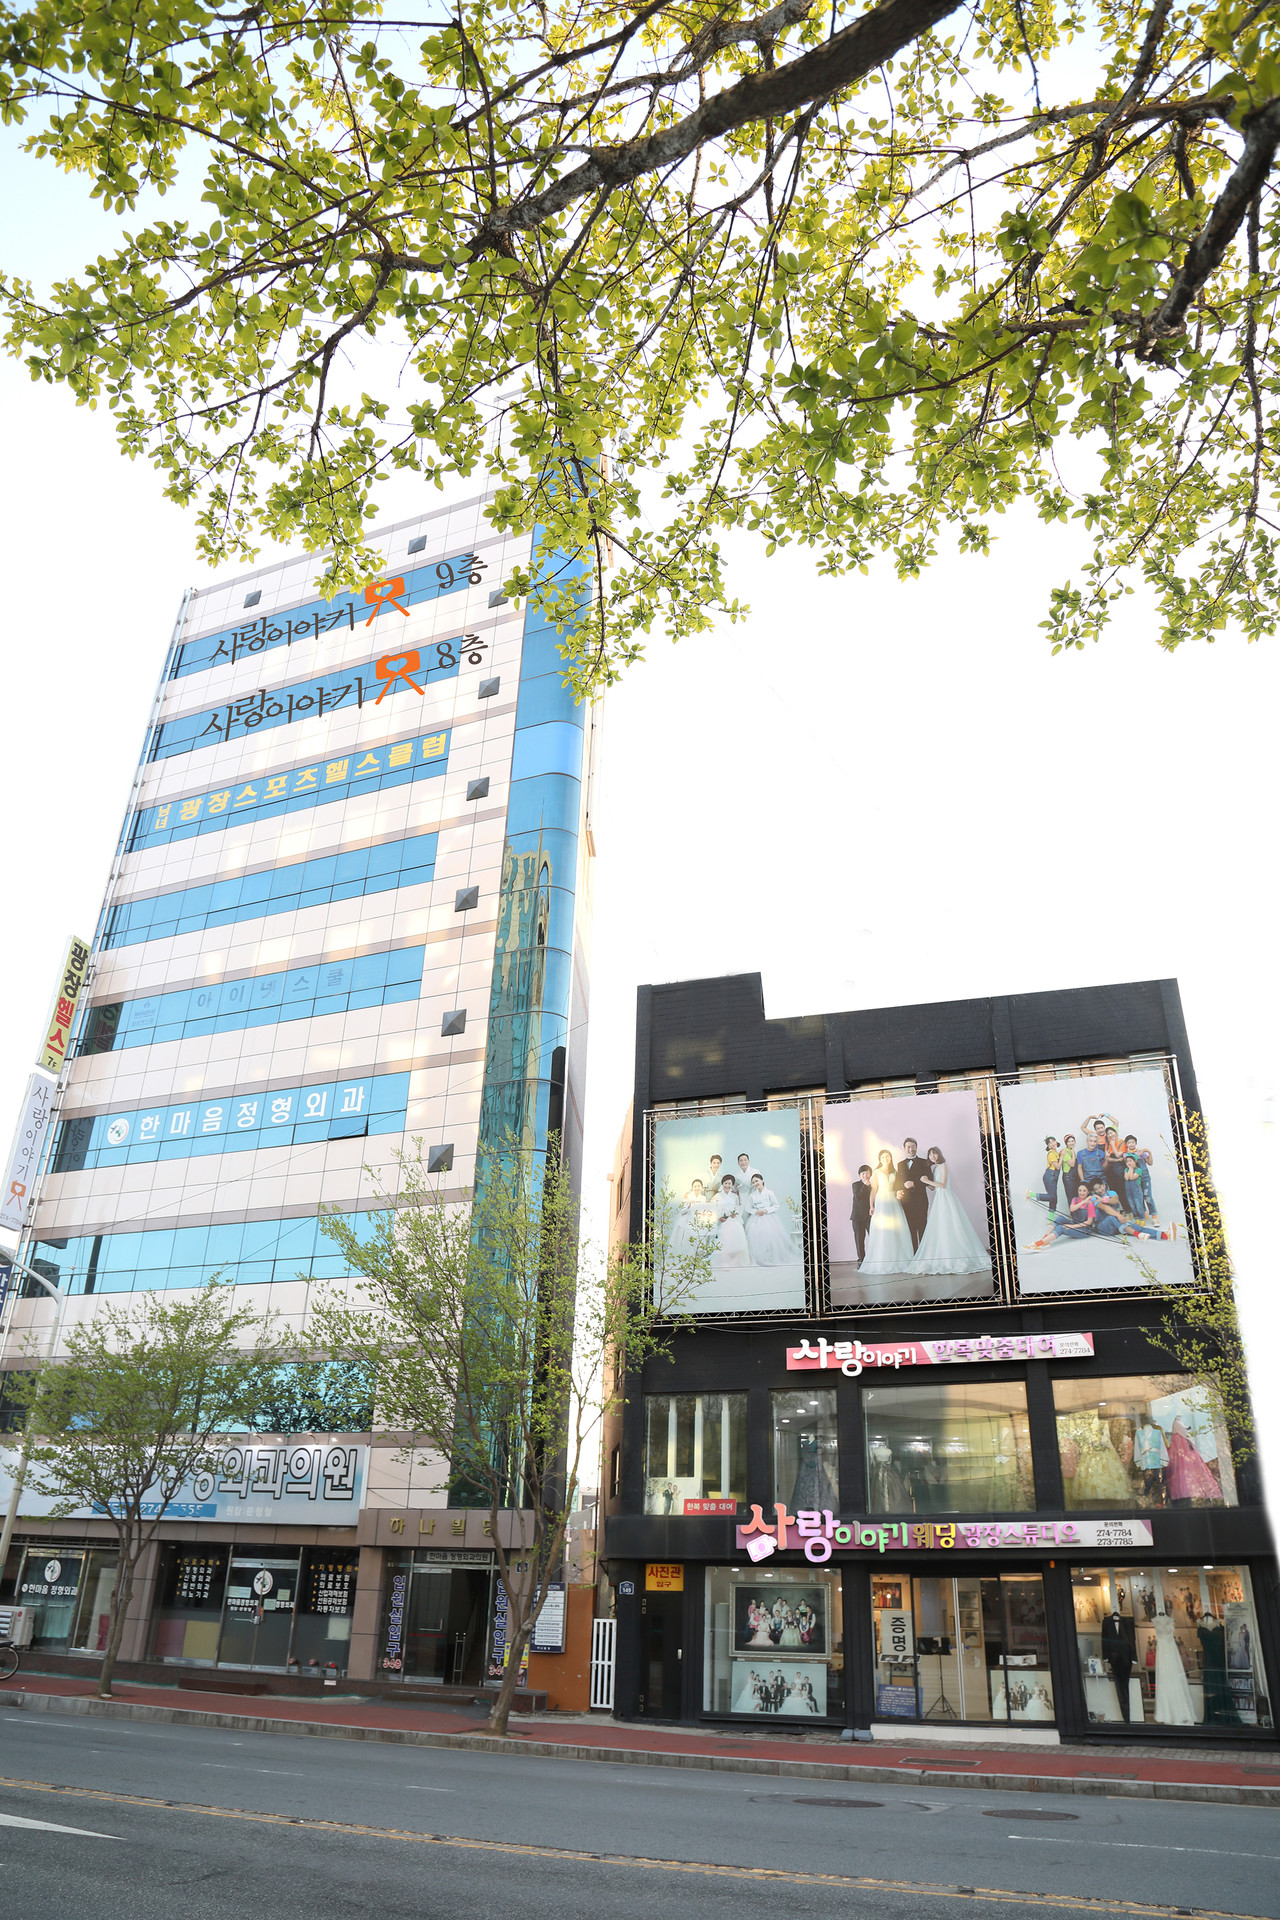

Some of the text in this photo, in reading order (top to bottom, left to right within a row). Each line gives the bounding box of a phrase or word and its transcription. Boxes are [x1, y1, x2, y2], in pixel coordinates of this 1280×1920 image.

[208, 553, 488, 665] 사랑이야기 9층
[201, 634, 488, 741] 사랑이야기 8층
[48, 1056, 57, 1069] 7F
[139, 1085, 366, 1140] 한마음정형외과
[16, 1086, 49, 1182] 사랑이야기
[792, 1337, 917, 1377] 사랑이야기
[686, 1502, 733, 1511] 한복 맞춤 대여
[740, 1502, 1081, 1563] 사랑이야기 웨딩 광장스튜디오
[1096, 1529, 1132, 1537] 274-7784
[1097, 1538, 1134, 1546] 273-7785
[648, 1565, 681, 1579] 사진관
[656, 1580, 671, 1588] 입구
[386, 1575, 406, 1658] 입원실입구
[891, 1617, 906, 1652] 증명
